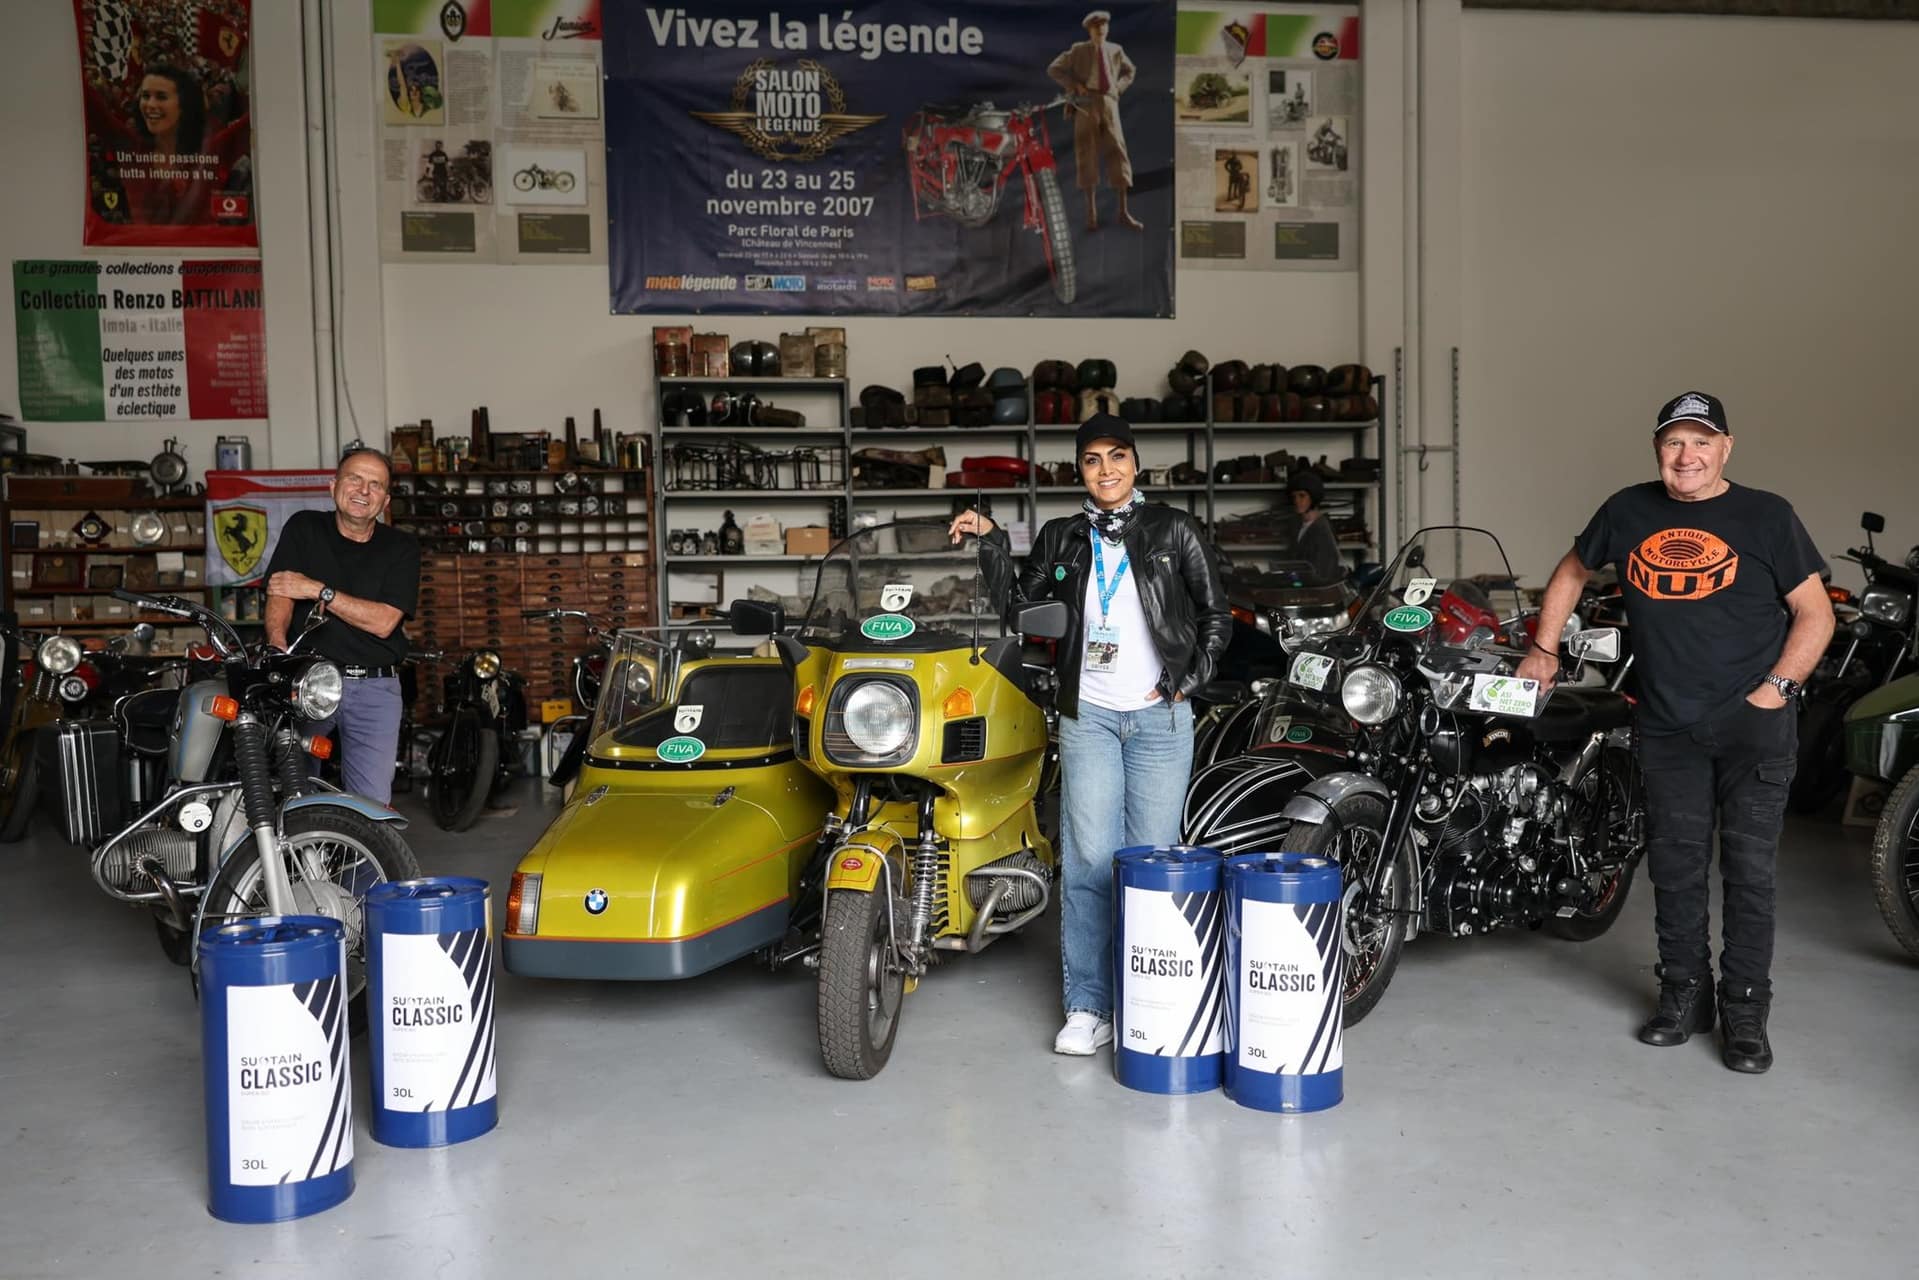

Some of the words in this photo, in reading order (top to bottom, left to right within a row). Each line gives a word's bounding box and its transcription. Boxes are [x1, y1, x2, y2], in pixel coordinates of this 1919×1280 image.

[646, 8, 759, 48] Vivez
[770, 12, 807, 50] la
[819, 11, 984, 60] légende
[755, 69, 820, 92] SALON
[755, 91, 821, 118] MOTO
[116, 151, 165, 163] Un'unica
[169, 152, 219, 165] passione
[120, 168, 146, 179] tutta
[150, 168, 189, 180] intorno
[192, 170, 199, 180] a
[726, 169, 751, 189] du
[761, 169, 788, 189] 23
[795, 174, 821, 190] au
[829, 170, 855, 190] 25
[706, 197, 816, 217] novembre
[823, 197, 875, 217] 2007
[728, 224, 757, 236] Parc
[760, 224, 799, 237] Floral
[802, 225, 817, 237] de
[821, 225, 854, 238] Paris
[782, 238, 794, 248] de
[23, 261, 44, 275] Les
[50, 261, 101, 276] grandes
[106, 261, 174, 275] collections
[21, 290, 107, 310] Collection
[113, 290, 166, 310] Renzo
[172, 290, 262, 310] BATTILANI
[102, 318, 138, 333] Imola
[150, 318, 182, 333] Italie
[102, 348, 154, 365] Quelques
[157, 350, 184, 362] unes
[115, 366, 135, 380] des
[138, 367, 174, 380] motos
[109, 384, 134, 398] d'un
[137, 384, 181, 397] esthète
[117, 401, 176, 416] éclectique
[1658, 530, 1710, 544] ANTIQUE
[1645, 548, 1721, 568] MOTORCYCLE
[1629, 561, 1733, 595] NUT
[1393, 612, 1421, 624] FIVA
[871, 621, 902, 631] FIVA
[666, 744, 694, 753] FIVA
[1131, 955, 1193, 977] CLASSIC
[1249, 970, 1315, 992] CLASSIC
[392, 1004, 463, 1027] CLASSIC
[1130, 1028, 1148, 1041] 30L
[1248, 1046, 1268, 1059] 30L
[240, 1061, 322, 1089] CLASSIC
[392, 1087, 414, 1099] 30L
[241, 1159, 268, 1170] 30L
